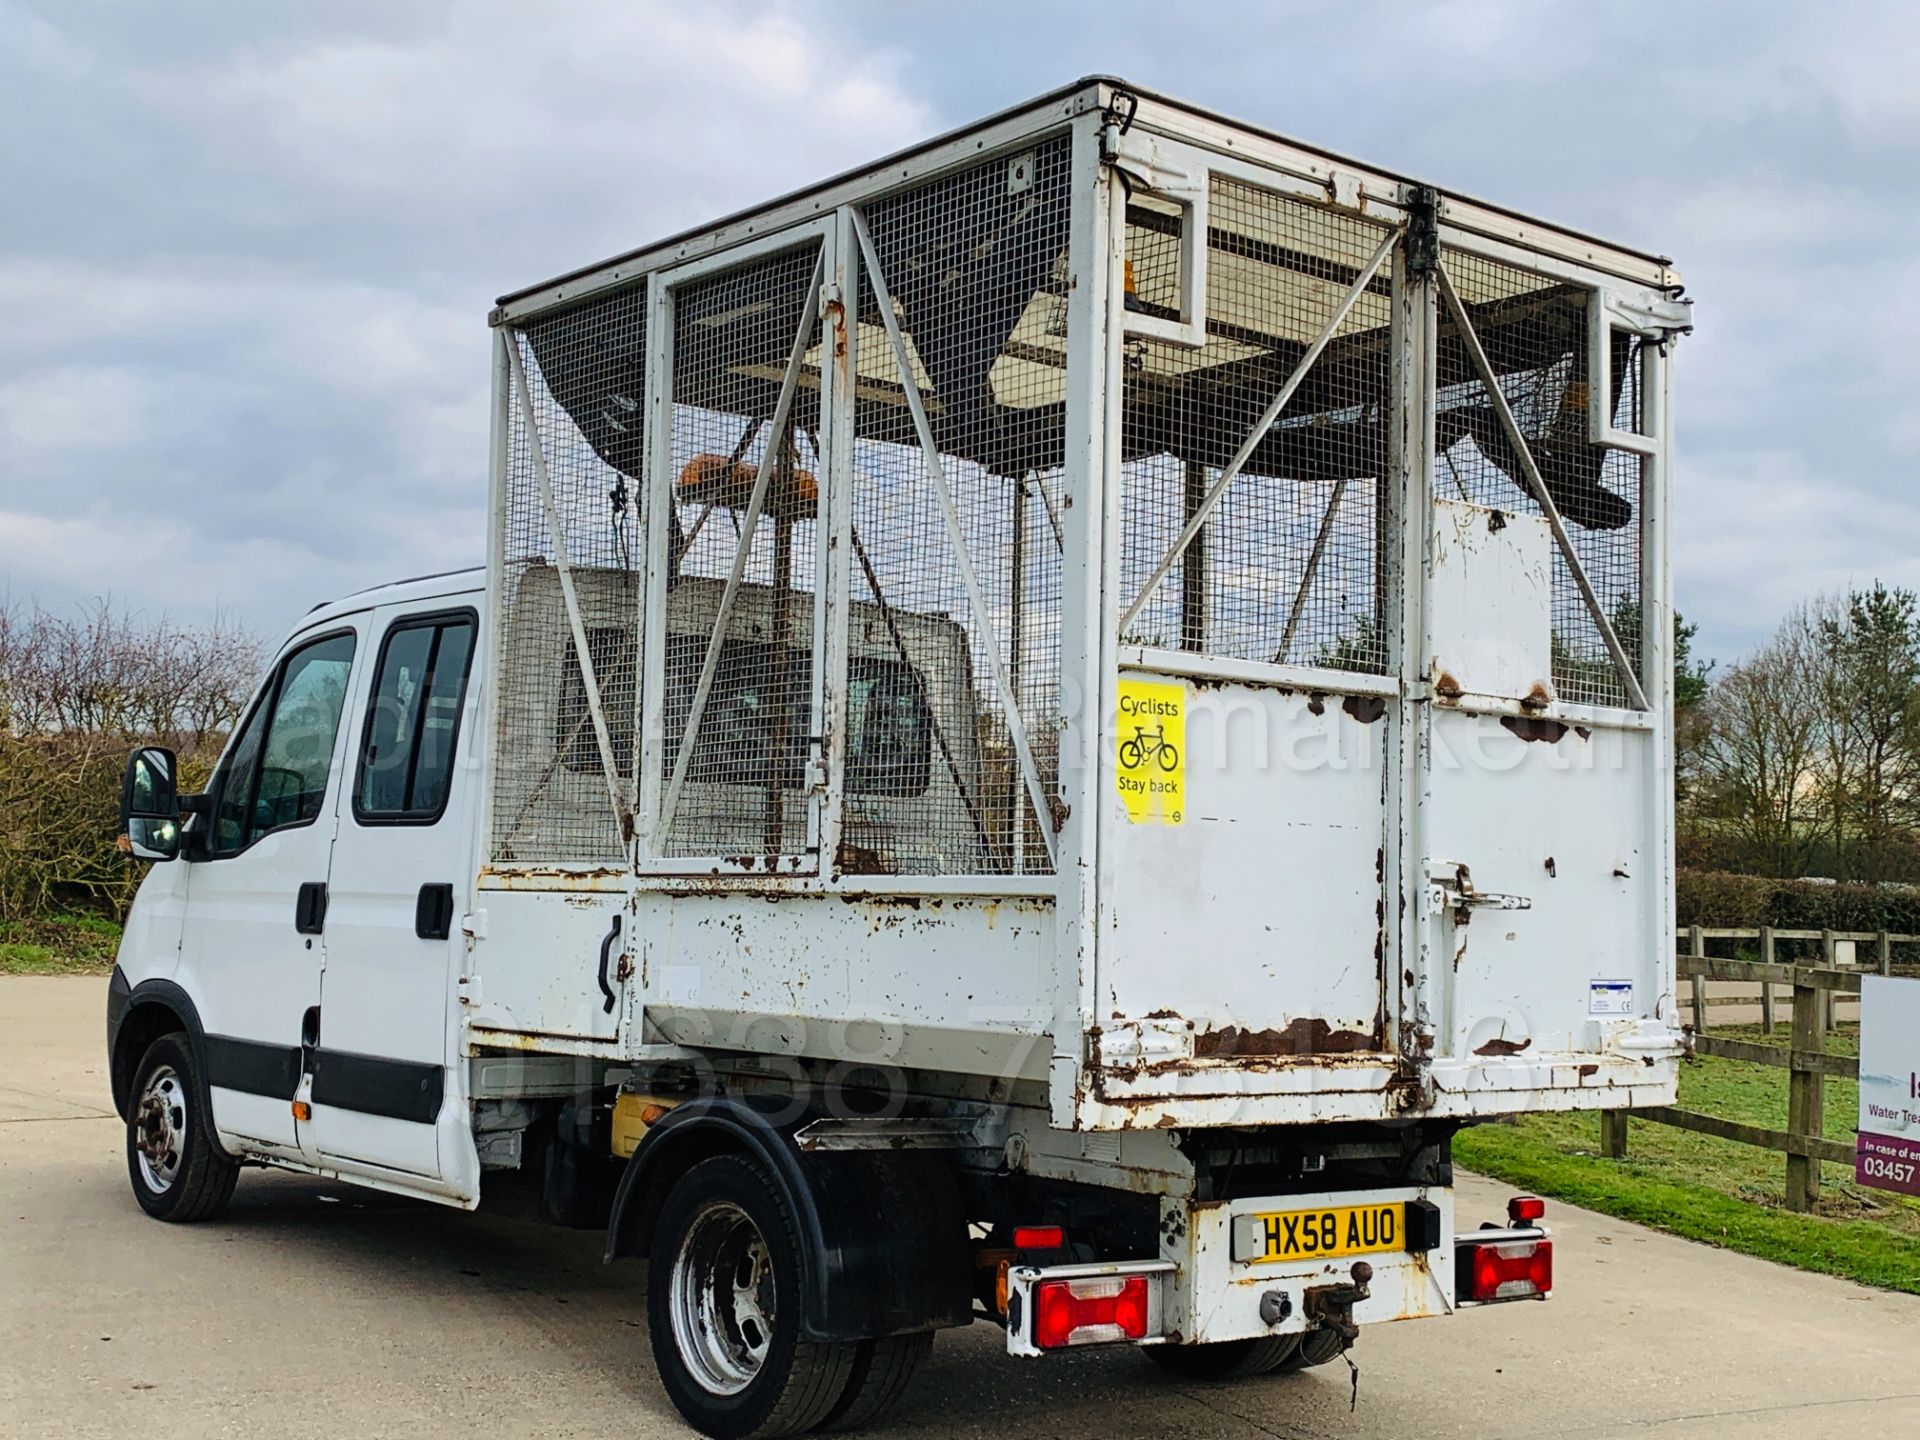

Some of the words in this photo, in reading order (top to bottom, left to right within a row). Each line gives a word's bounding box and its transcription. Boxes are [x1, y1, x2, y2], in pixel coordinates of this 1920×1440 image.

[1120, 695, 1178, 716] Cyclists
[1119, 776, 1145, 794] Stay
[1150, 779, 1178, 794] back
[1868, 1104, 1899, 1120] Water
[1865, 1141, 1874, 1151] In
[1876, 1145, 1897, 1157] case
[1899, 1149, 1909, 1158] of
[1864, 1157, 1915, 1183] 03457
[1264, 1213, 1337, 1256] HX58
[1346, 1209, 1394, 1249] AUO
